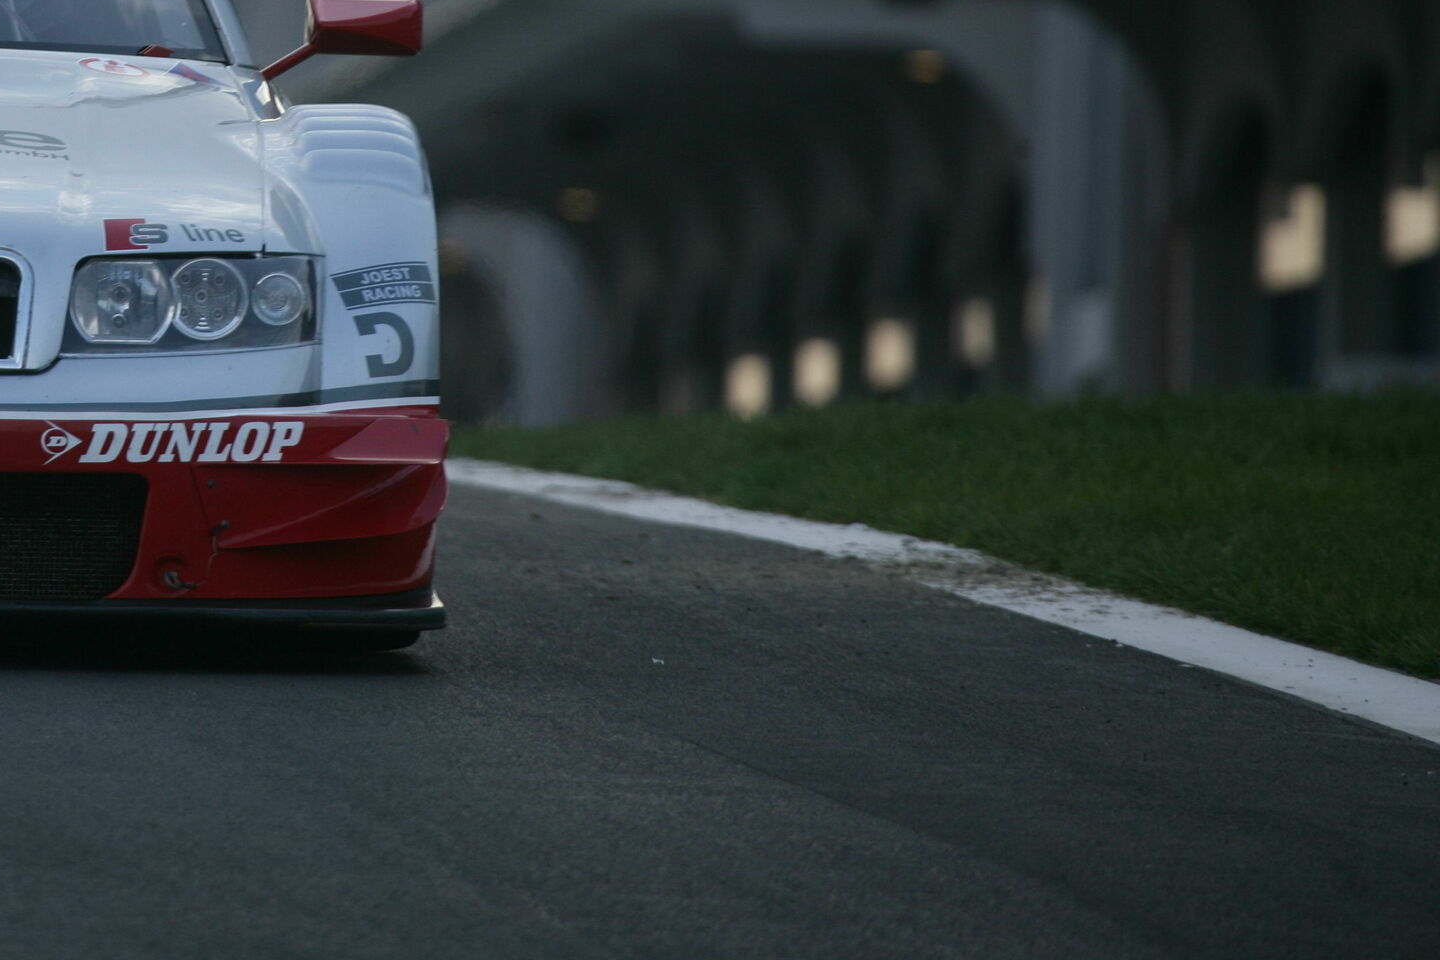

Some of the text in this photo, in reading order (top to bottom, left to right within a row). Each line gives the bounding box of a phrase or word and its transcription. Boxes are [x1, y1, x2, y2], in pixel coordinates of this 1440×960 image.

[180, 223, 246, 243] line
[360, 267, 411, 285] JOEST
[361, 284, 422, 302] RACING
[78, 422, 304, 464] DUNLOP
